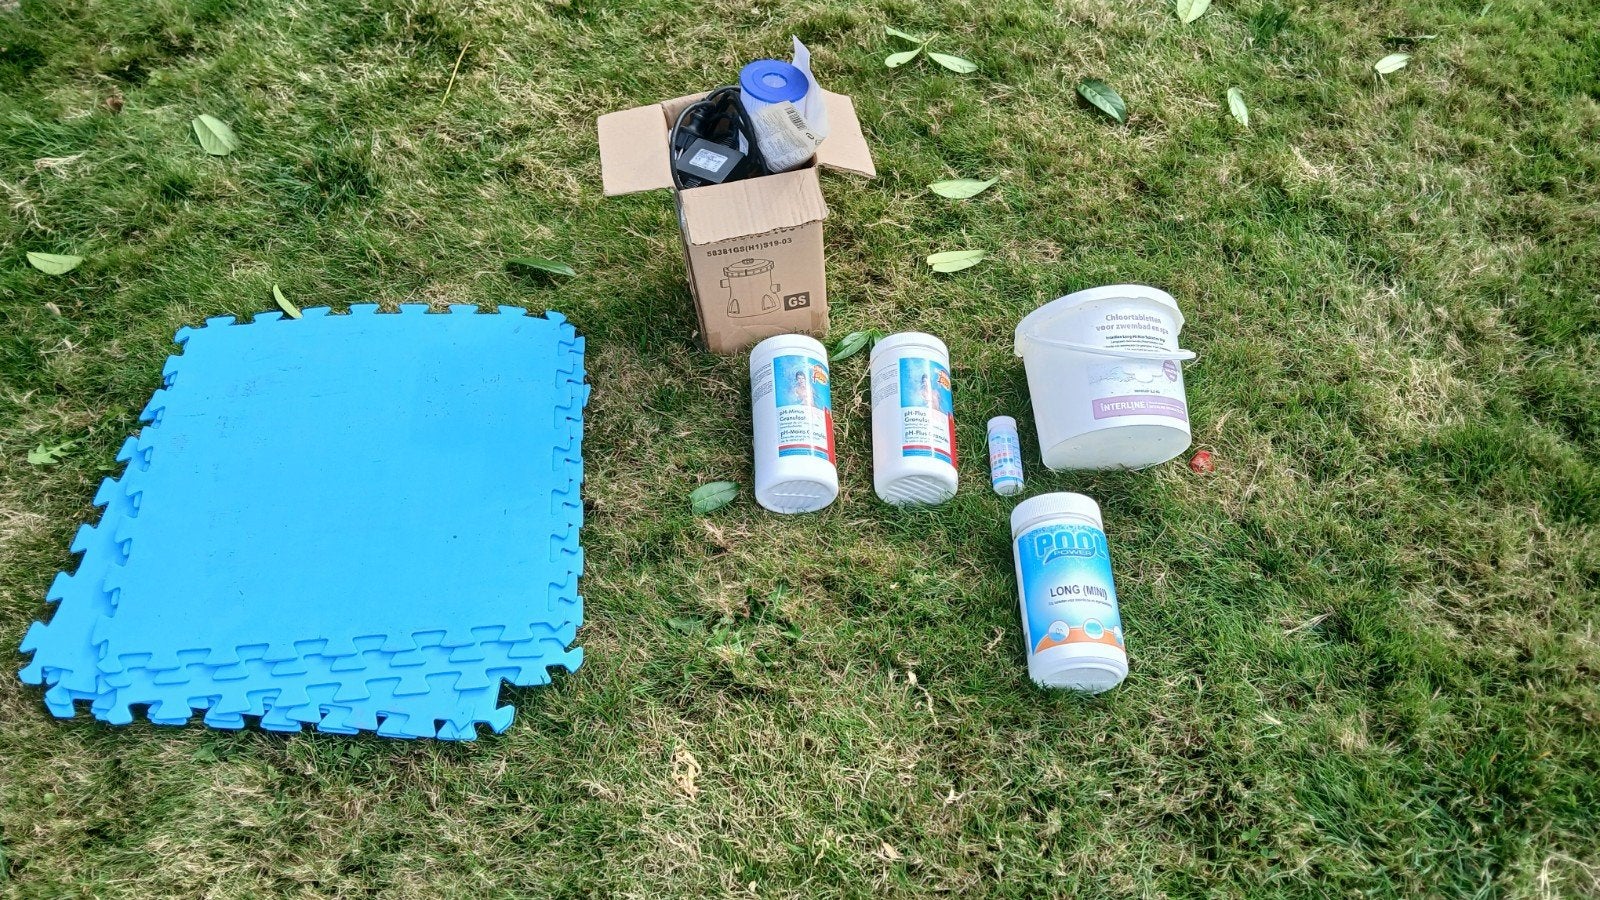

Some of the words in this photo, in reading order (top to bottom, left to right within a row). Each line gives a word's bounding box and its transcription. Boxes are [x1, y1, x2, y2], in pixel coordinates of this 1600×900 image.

[788, 295, 807, 308] GS
[1105, 313, 1161, 324] Chloortabletten
[1095, 324, 1114, 332] voor
[1115, 322, 1151, 331] zwembad
[904, 430, 928, 438] pH-Plus
[1035, 531, 1108, 560] POOL
[1053, 548, 1092, 557] POWER
[1050, 584, 1081, 598] LONG
[1082, 585, 1108, 601] (MINI)
